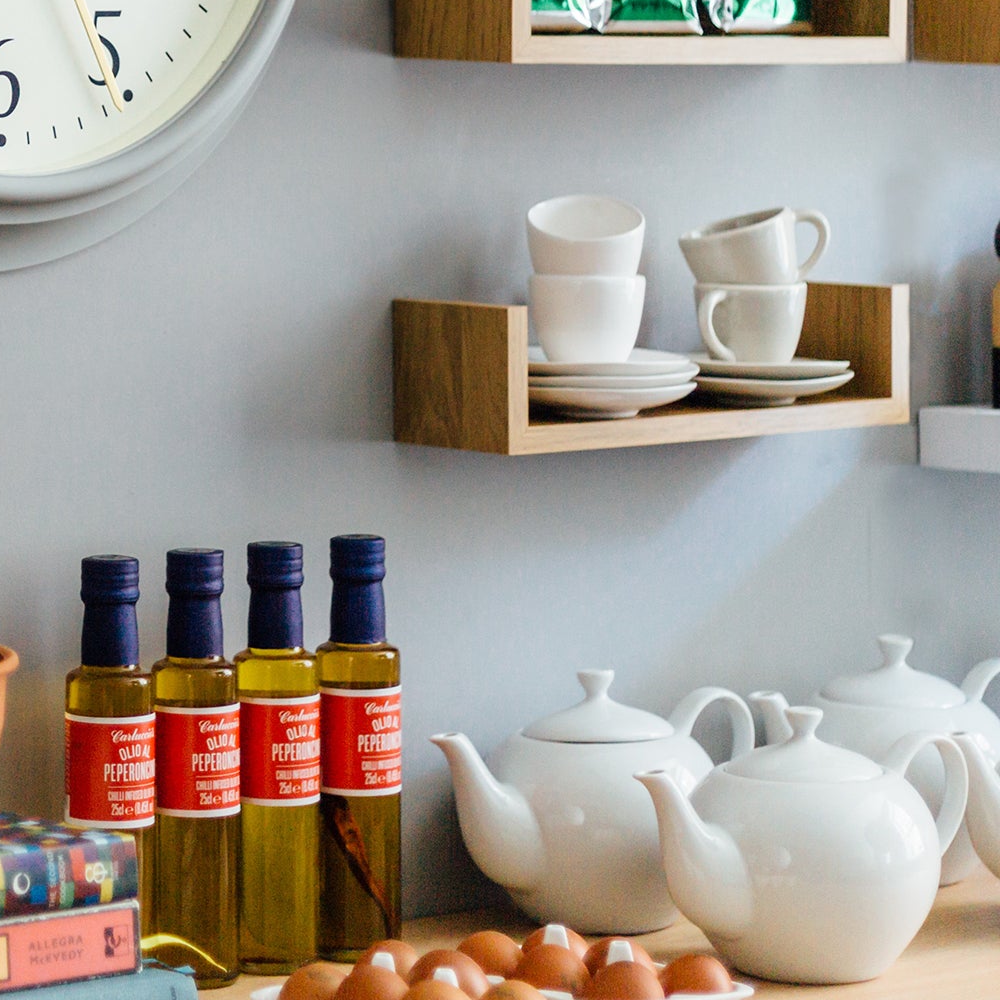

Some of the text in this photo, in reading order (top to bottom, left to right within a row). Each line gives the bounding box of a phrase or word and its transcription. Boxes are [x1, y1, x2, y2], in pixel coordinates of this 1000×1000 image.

[88, 10, 122, 87] 5
[206, 734, 228, 751] OLIO
[118, 744, 142, 762] OLIO
[28, 934, 84, 951] ALLEGRA
